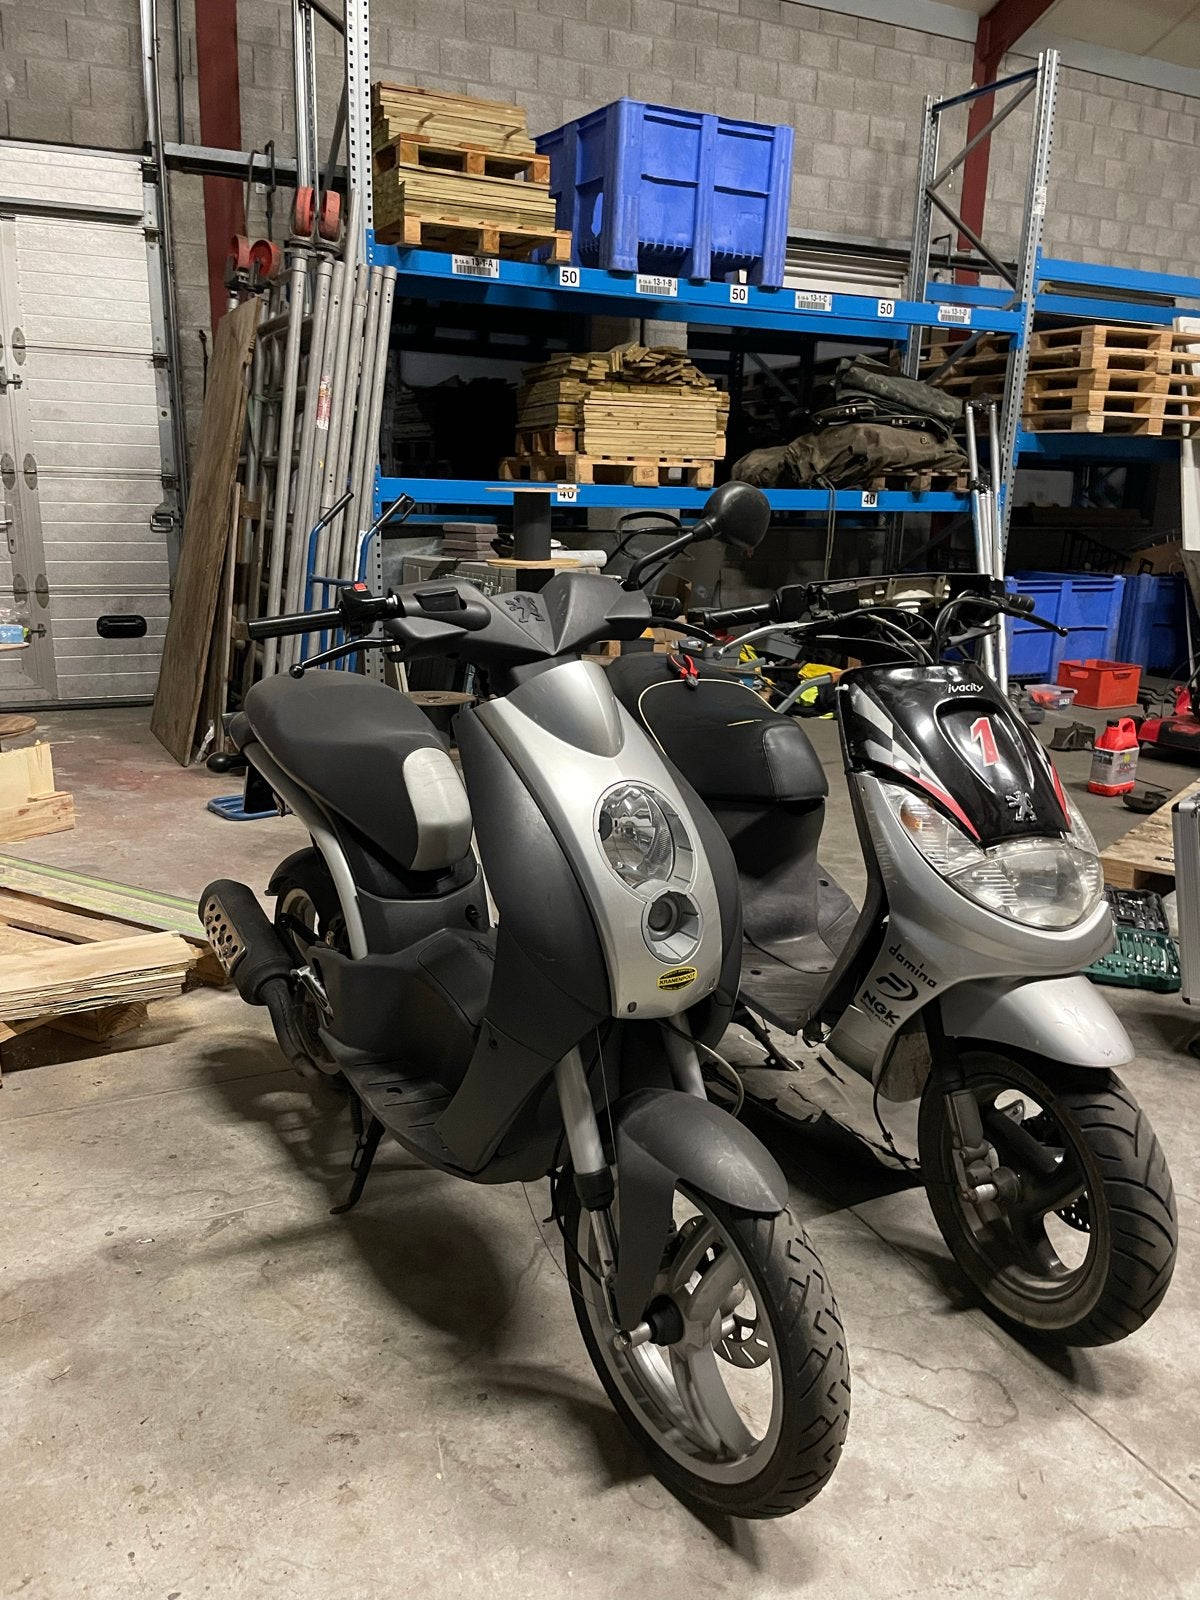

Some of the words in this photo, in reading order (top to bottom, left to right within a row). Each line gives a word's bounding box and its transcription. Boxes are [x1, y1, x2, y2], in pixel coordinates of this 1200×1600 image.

[561, 270, 578, 284] 50
[732, 288, 746, 301] 50
[879, 303, 893, 315] 50
[863, 494, 876, 505] 40
[970, 716, 1001, 767] 1
[862, 989, 900, 1025] NGK
